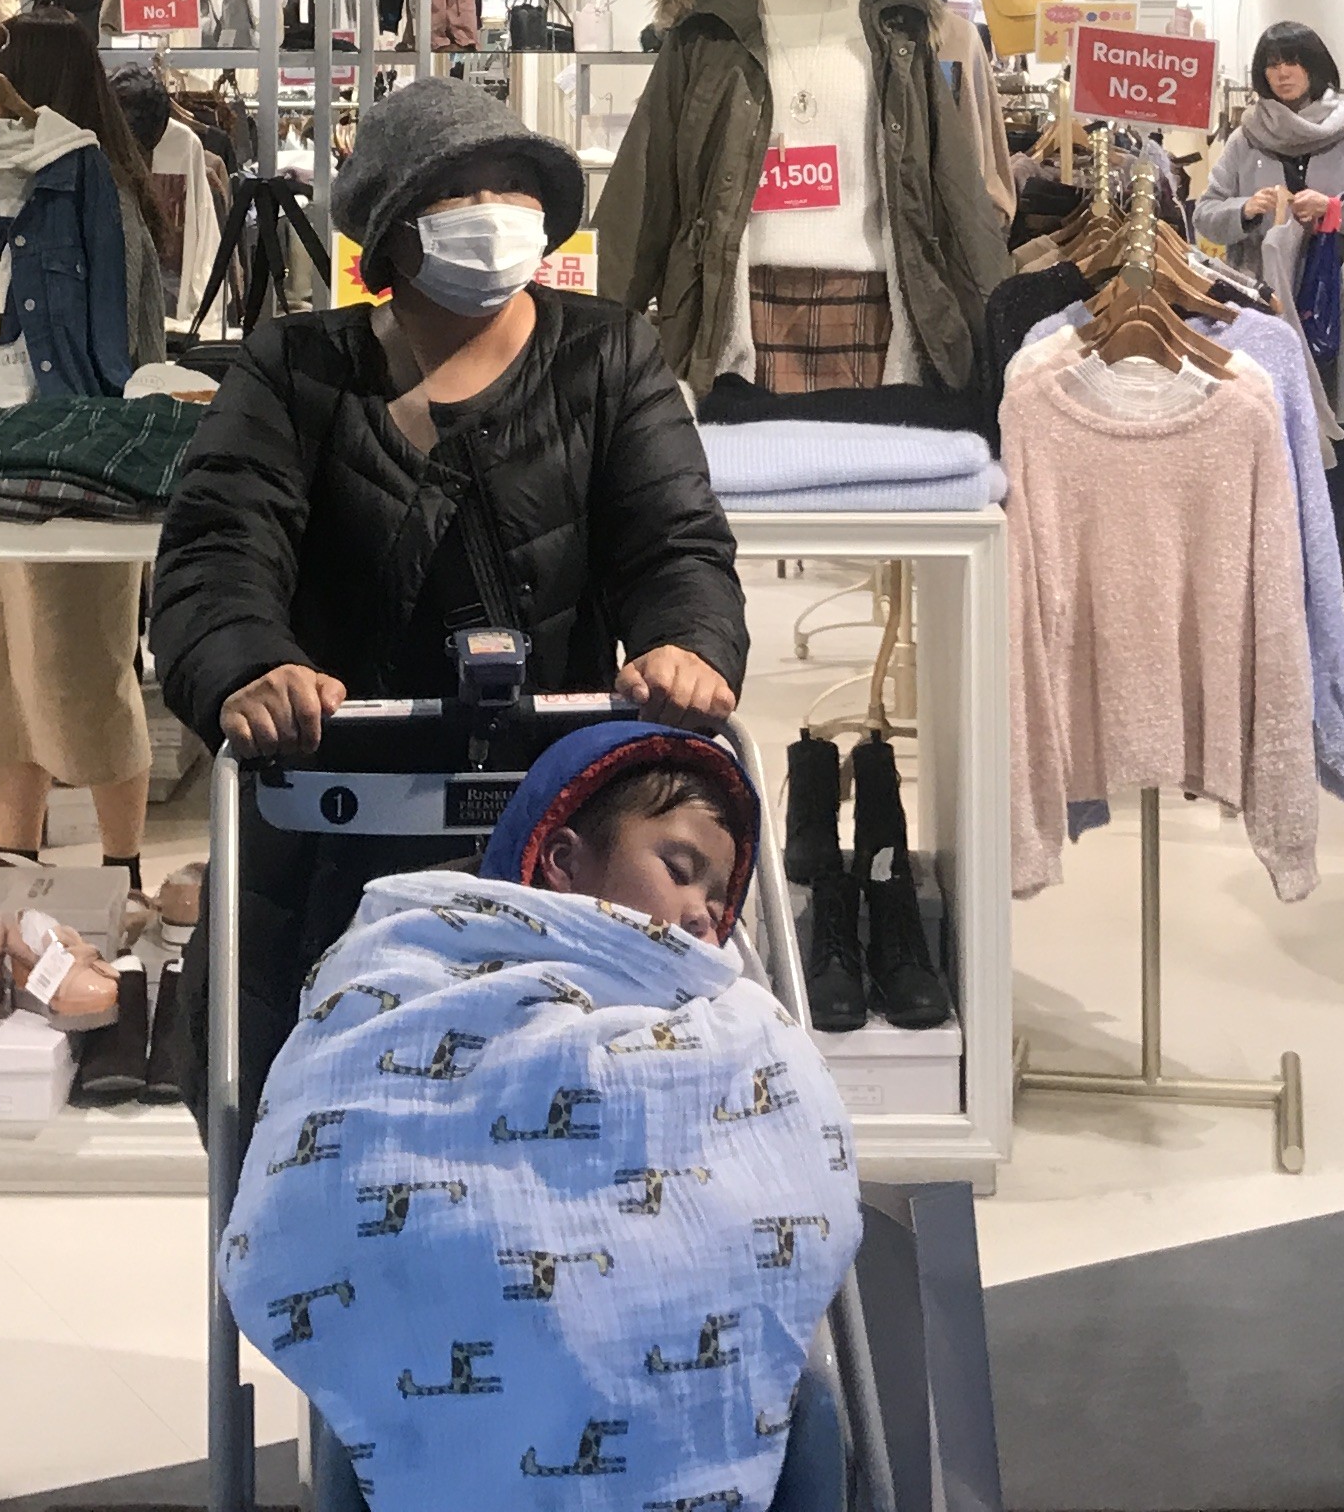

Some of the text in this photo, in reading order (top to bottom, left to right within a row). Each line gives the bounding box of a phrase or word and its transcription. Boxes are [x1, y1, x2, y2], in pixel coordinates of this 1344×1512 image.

[143, 1, 177, 20] No.1
[1093, 41, 1199, 78] Ranking
[1109, 76, 1178, 106] No.2
